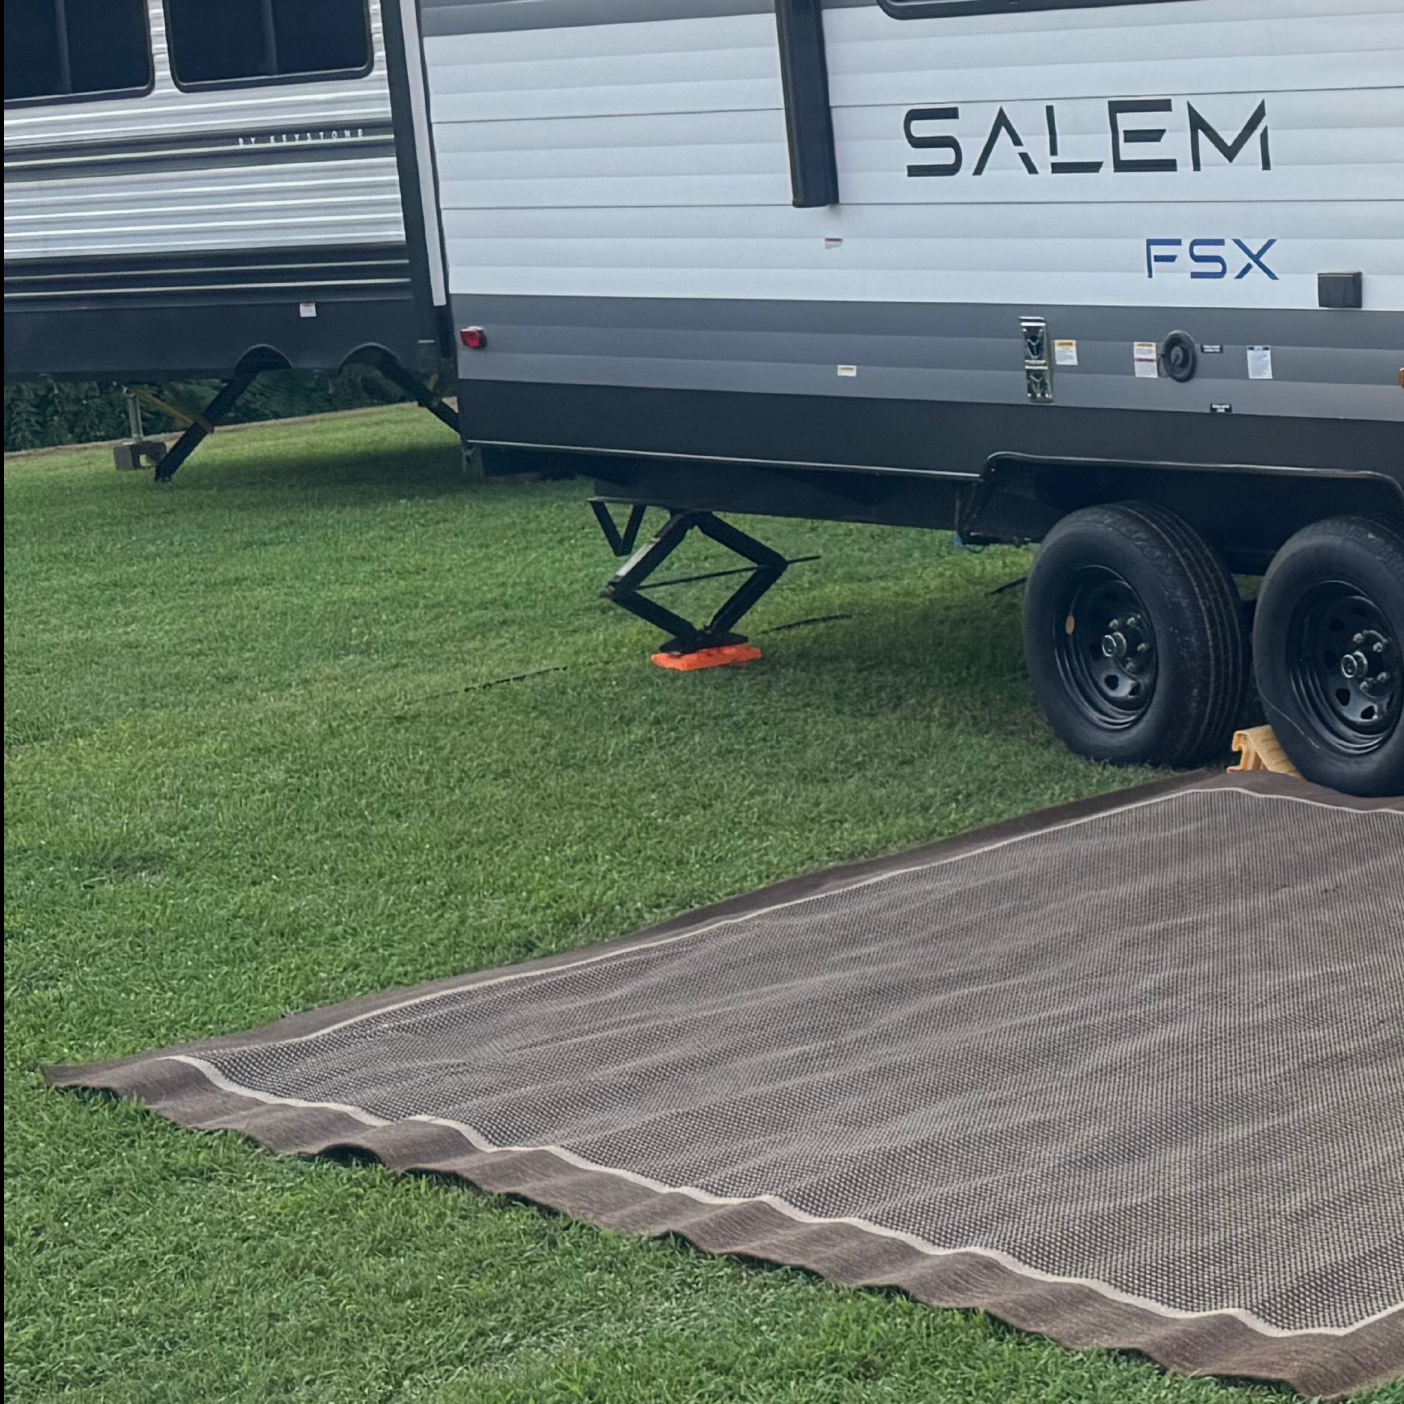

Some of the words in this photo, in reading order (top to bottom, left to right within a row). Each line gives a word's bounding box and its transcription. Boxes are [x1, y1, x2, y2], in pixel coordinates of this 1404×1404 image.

[269, 128, 364, 144] KEYSTONE
[903, 97, 1272, 178] SALEM
[1145, 238, 1280, 280] FSX
